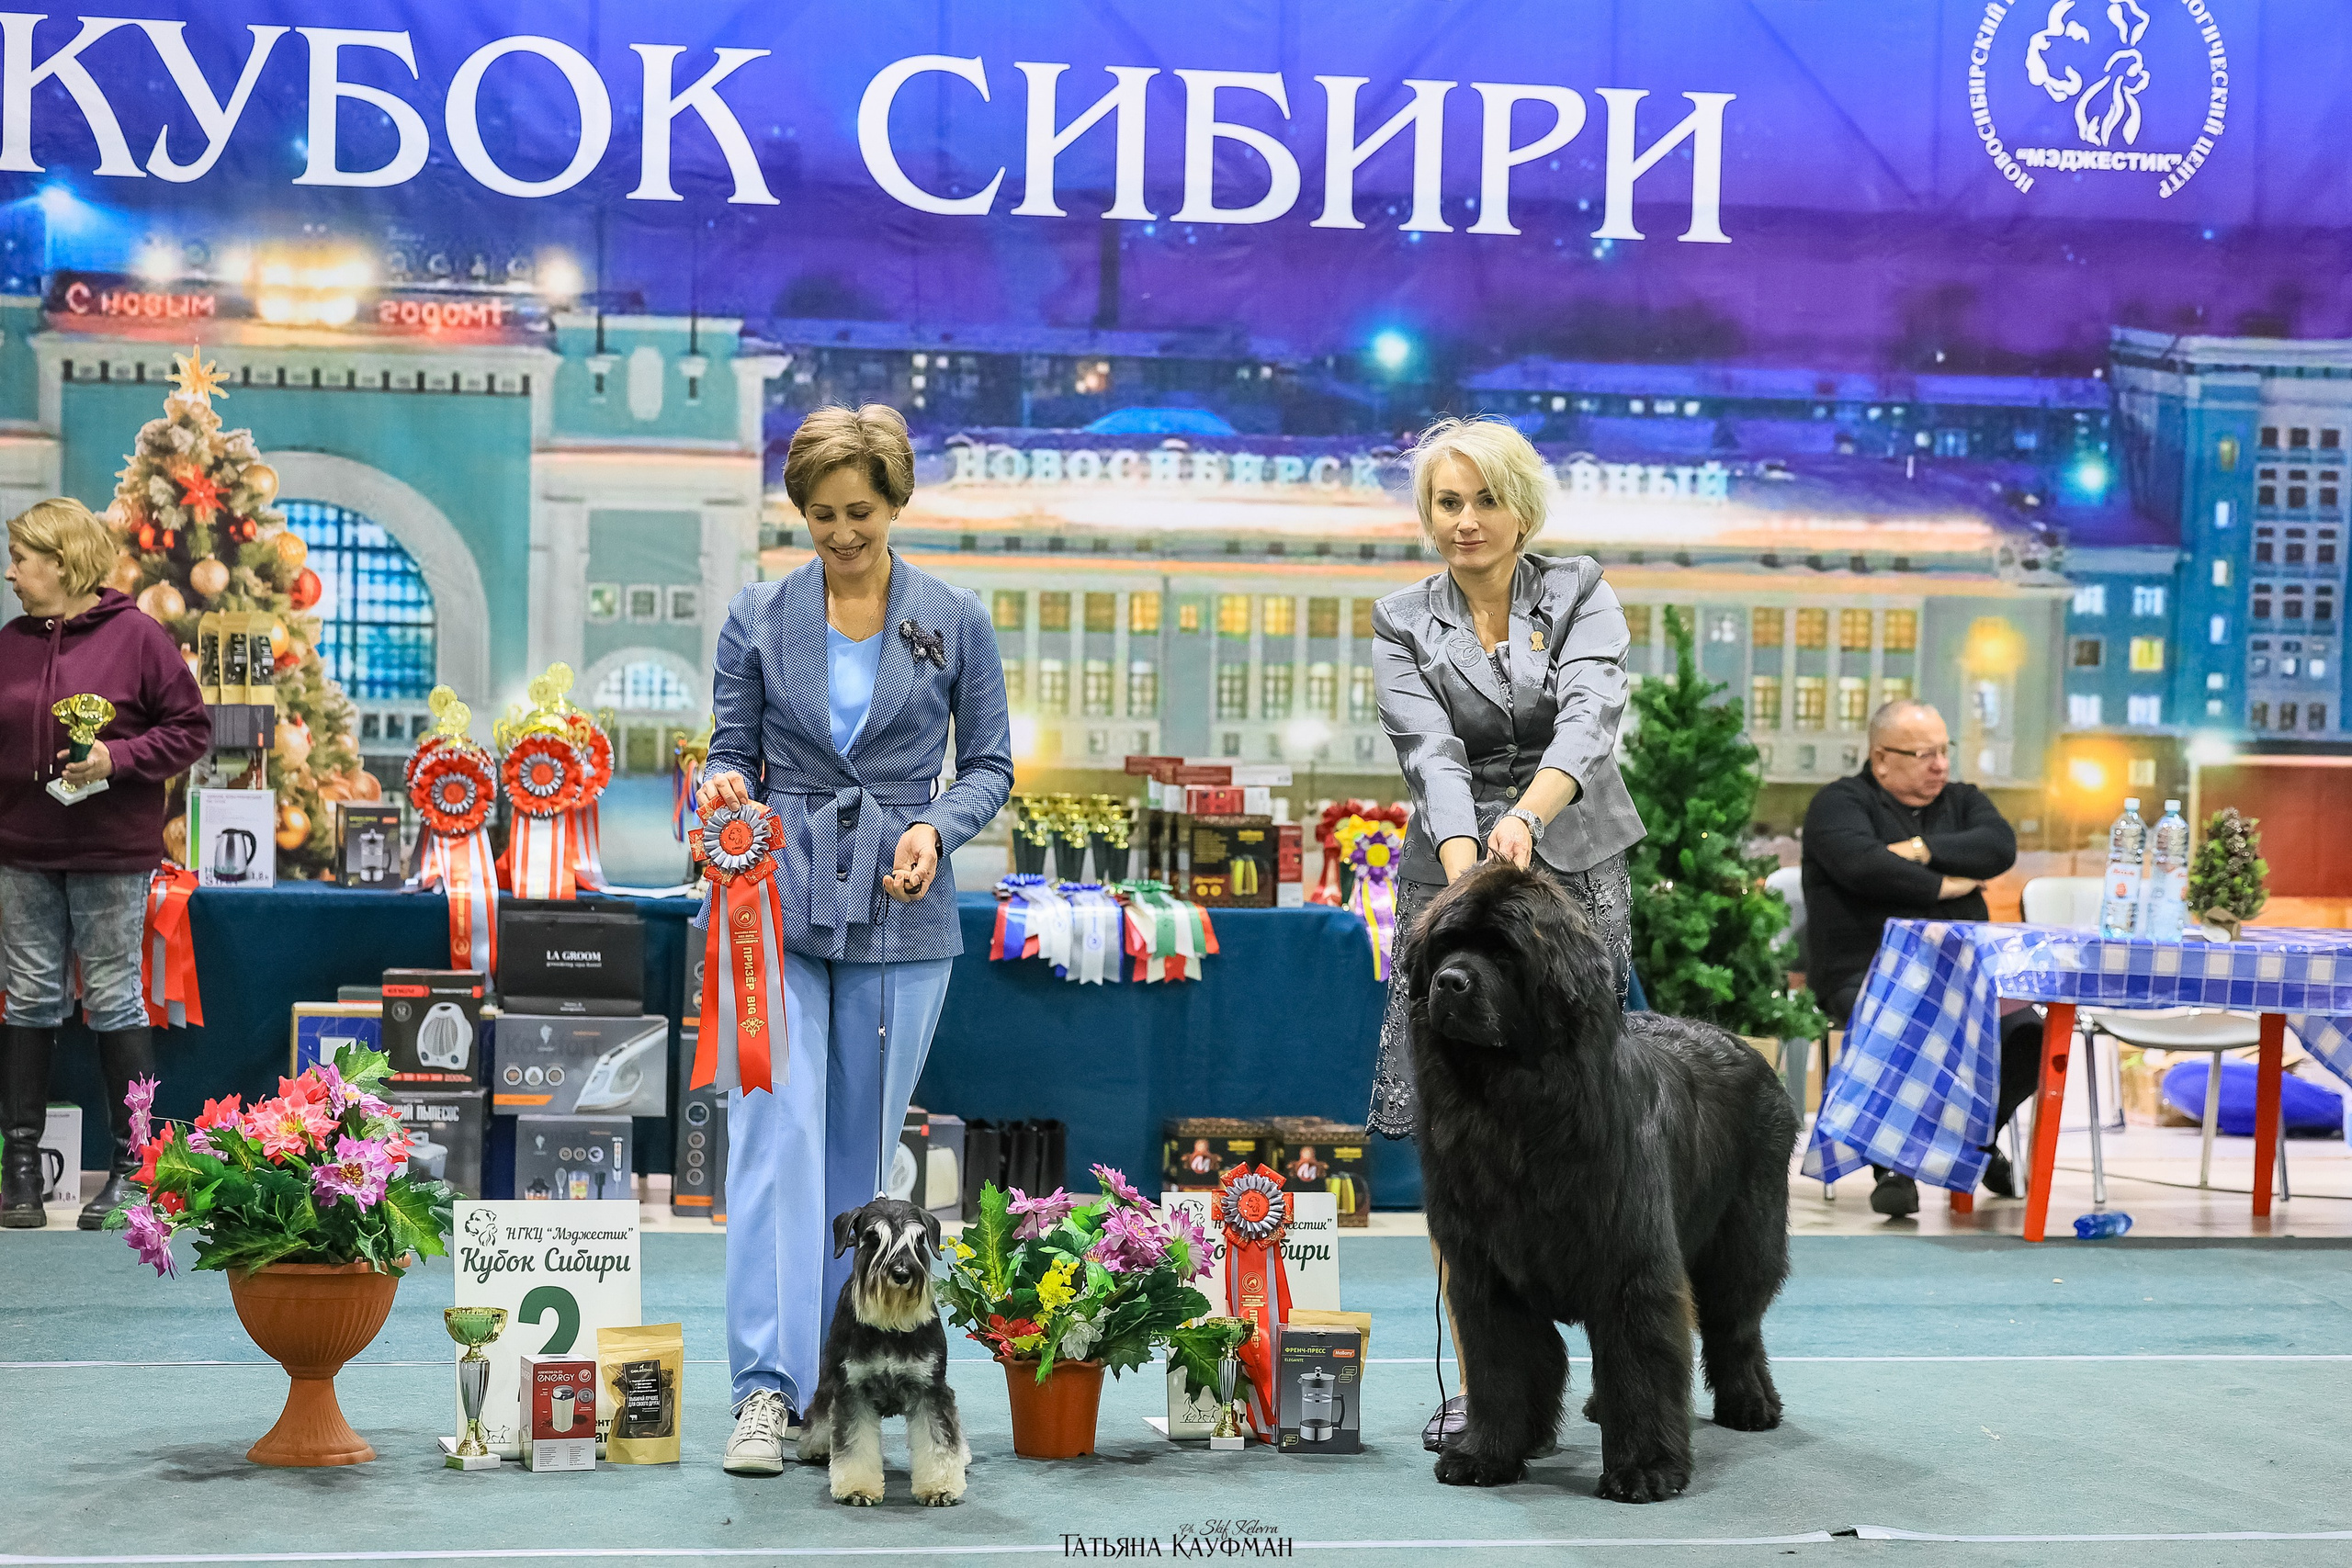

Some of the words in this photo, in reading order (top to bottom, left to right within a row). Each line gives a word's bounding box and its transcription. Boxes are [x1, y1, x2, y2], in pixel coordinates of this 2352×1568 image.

[0, 13, 781, 206] КУБОК
[856, 53, 1737, 243] СИБИРИ
[951, 445, 1385, 492] НОВОСИБИРСК
[1555, 460, 1730, 502] ВНЫЙ
[742, 946, 757, 992] ПРИЗЁР
[746, 995, 757, 1015] BIG
[505, 1226, 543, 1243] НГКЦ
[460, 1247, 536, 1284] Кубок
[544, 1247, 631, 1283] Сибири
[517, 1285, 581, 1355] 2
